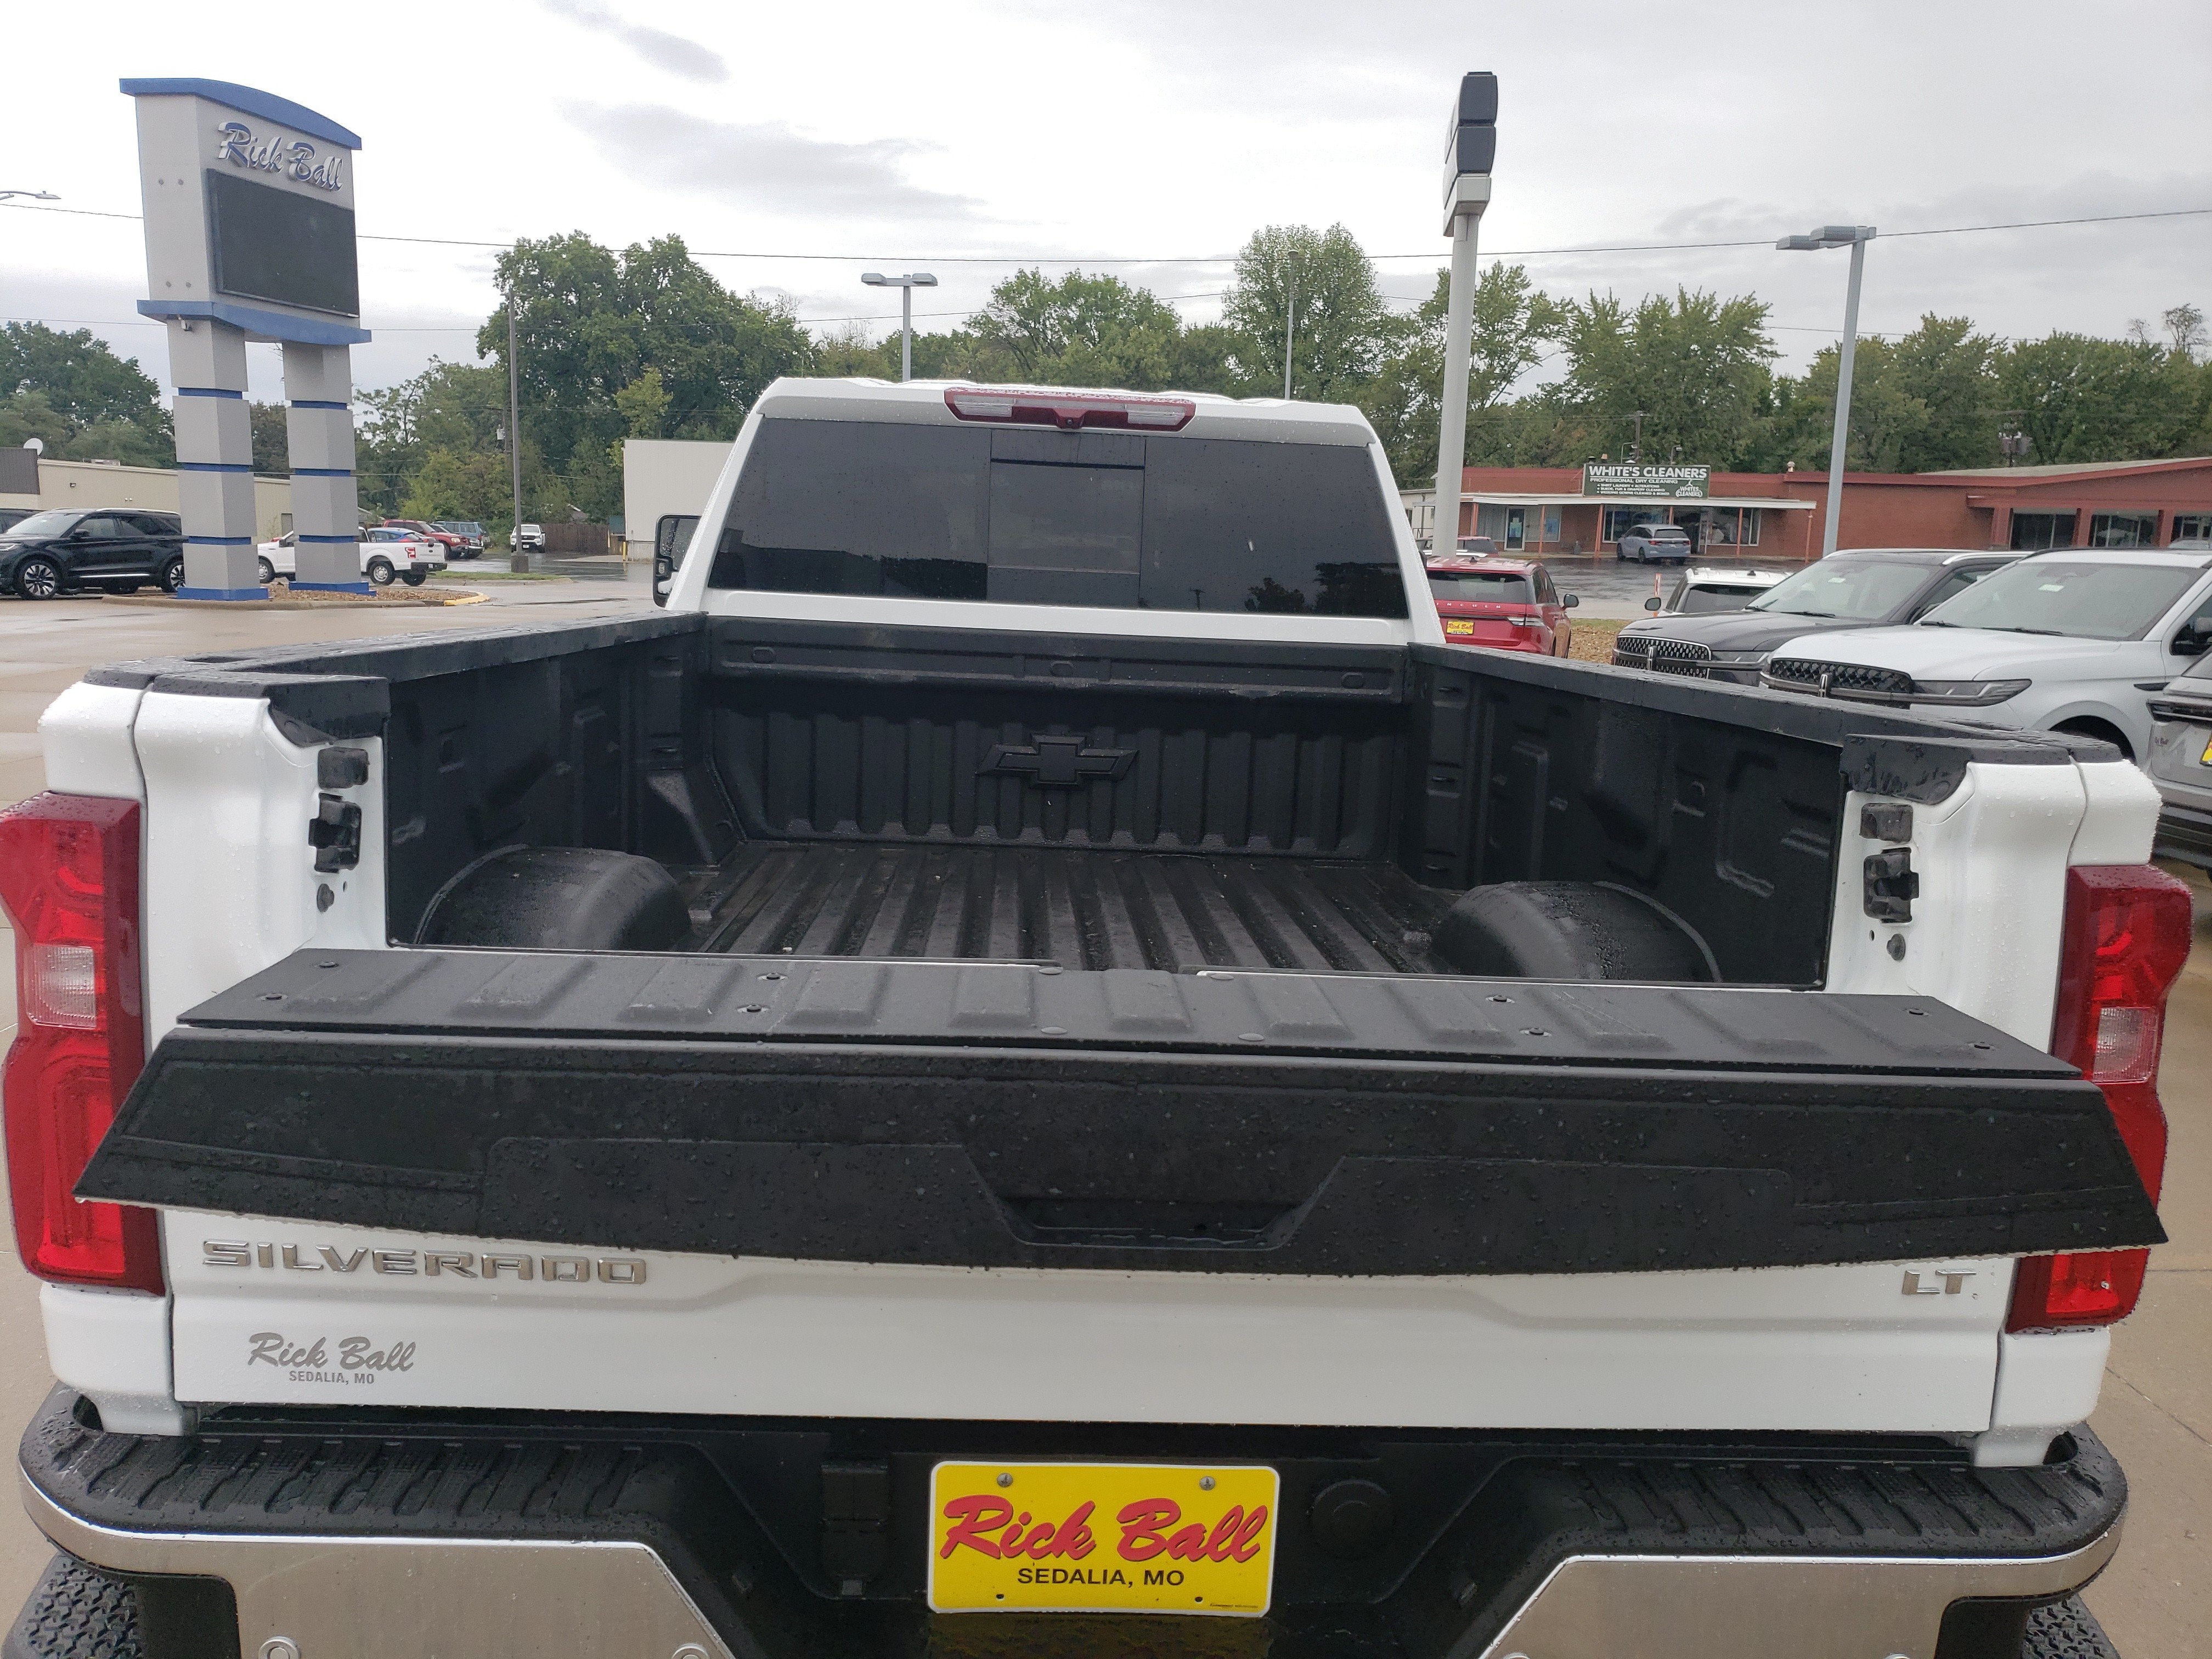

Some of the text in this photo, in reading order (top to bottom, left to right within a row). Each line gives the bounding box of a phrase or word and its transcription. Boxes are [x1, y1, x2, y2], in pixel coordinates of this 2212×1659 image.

[218, 122, 343, 191] Rick Ball
[1589, 466, 1707, 478] WHITE'S CLEANERS
[203, 1238, 647, 1285] SILVERADO
[1902, 1268, 1977, 1295] LT
[247, 1331, 416, 1373] Rick Ball
[289, 1370, 375, 1385] SEDALIA, MO
[939, 1494, 1268, 1563] Rick Ball
[1017, 1567, 1185, 1588] SEDALIA, MO
